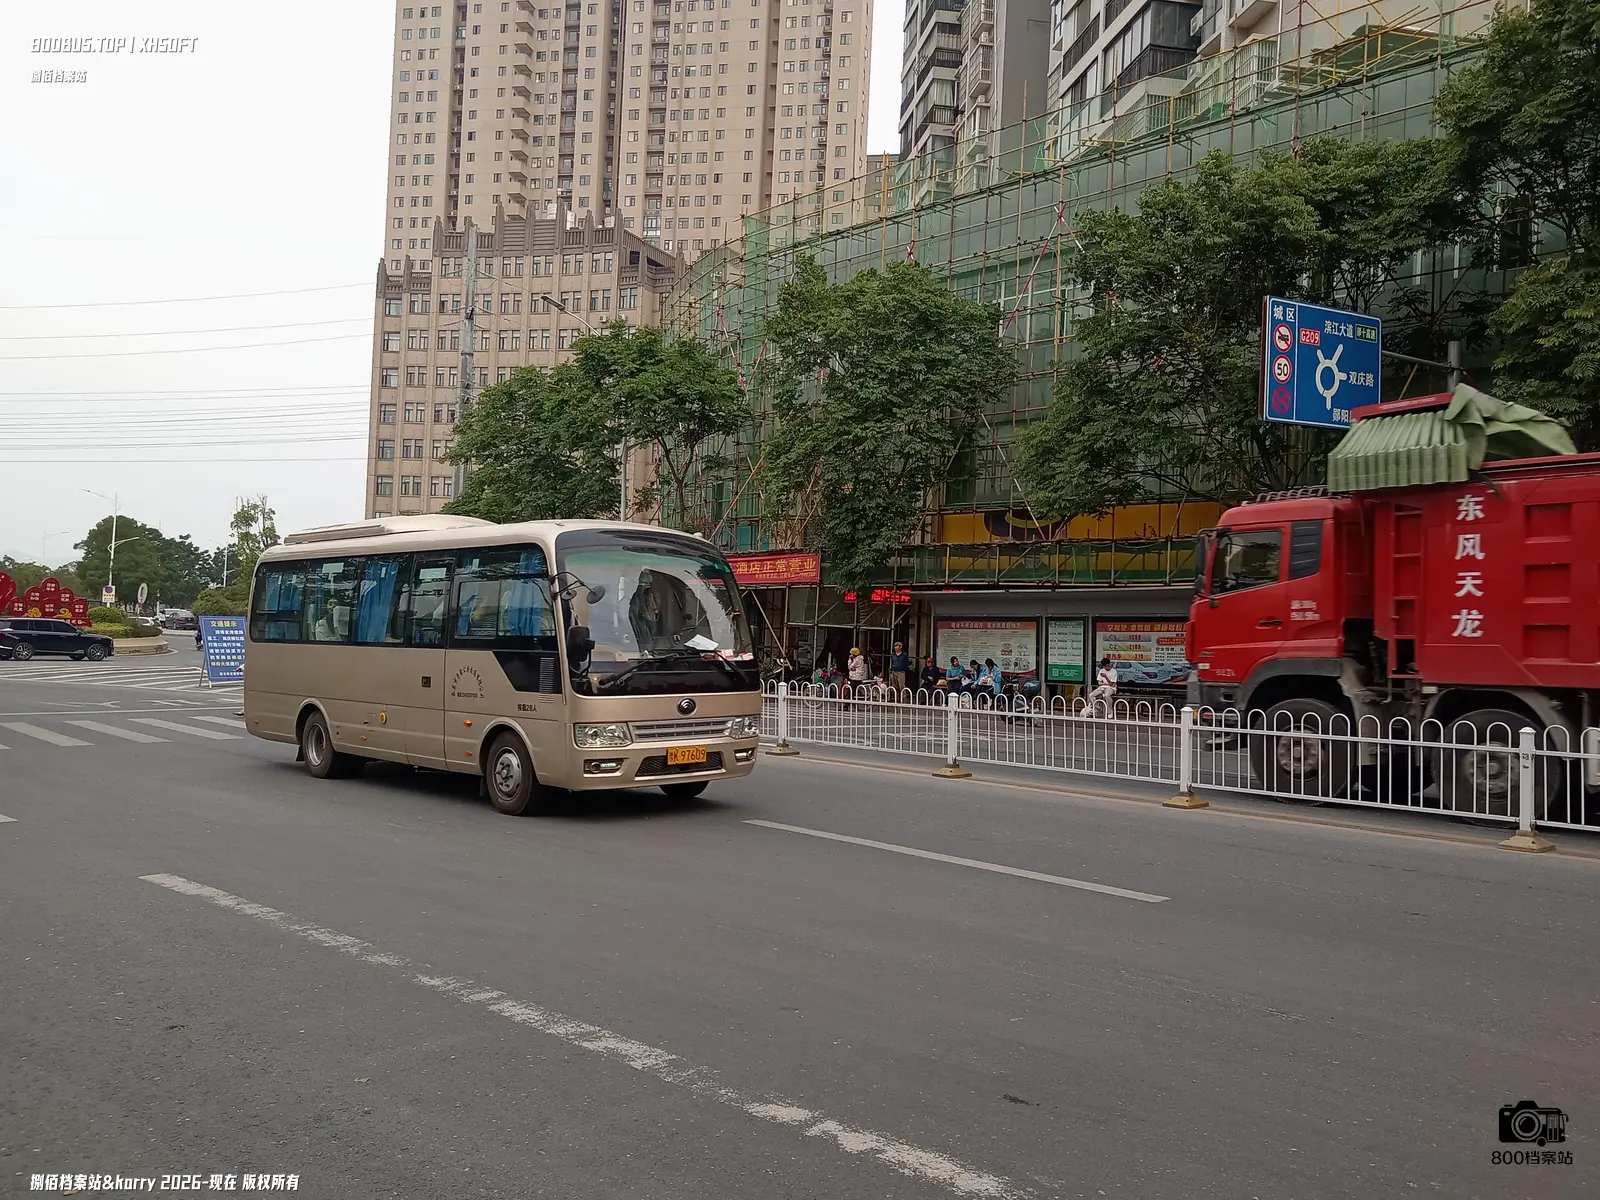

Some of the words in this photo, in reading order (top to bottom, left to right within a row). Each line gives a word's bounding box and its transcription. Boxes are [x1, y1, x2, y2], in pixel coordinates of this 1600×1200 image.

[1273, 305, 1296, 321] 城区
[1301, 330, 1319, 343] G209
[1324, 320, 1354, 338] 滨江大道
[1276, 363, 1288, 377] 50
[1348, 371, 1374, 387] 双庆路
[729, 558, 816, 575] 酒店正常营业
[1451, 494, 1486, 638] 东风天龙
